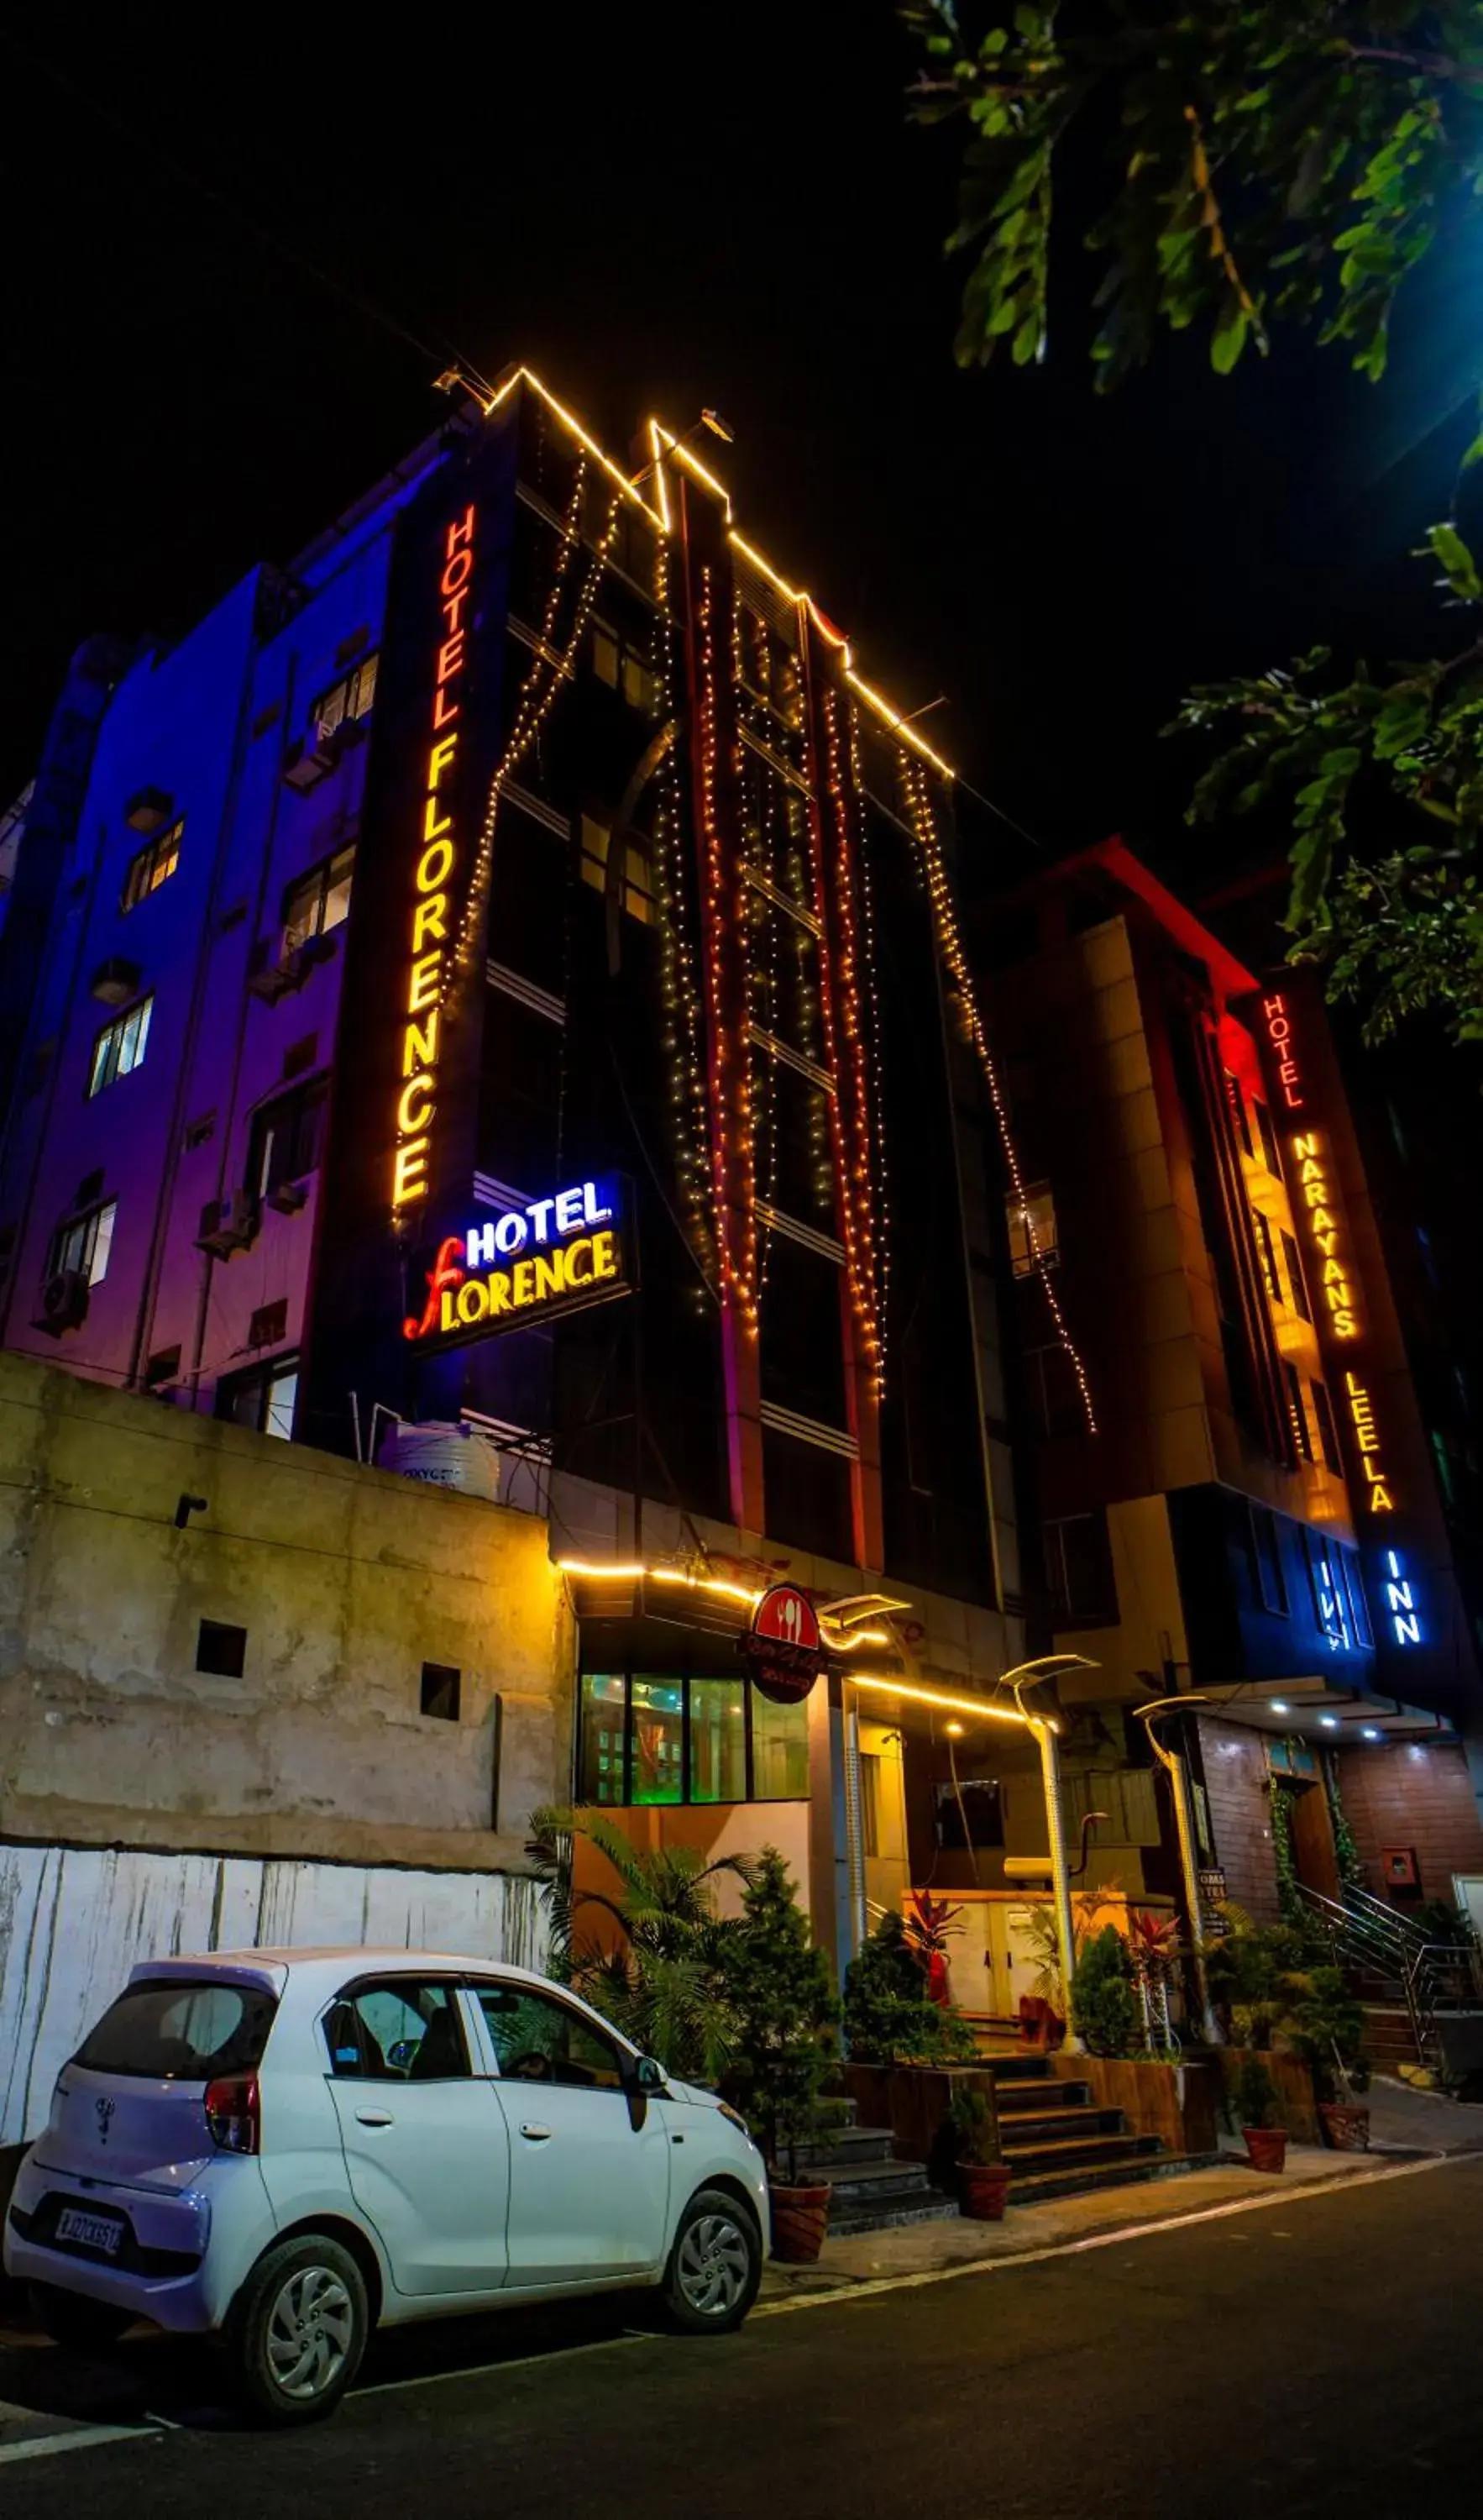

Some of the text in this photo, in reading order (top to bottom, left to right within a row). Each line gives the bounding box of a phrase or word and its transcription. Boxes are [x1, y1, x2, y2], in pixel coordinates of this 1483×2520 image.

[394, 504, 474, 1206] HOTEL FLORENCE
[466, 1182, 612, 1269] HOTEL
[1263, 995, 1421, 1645] HOTEL NARAYANS LEELA INN
